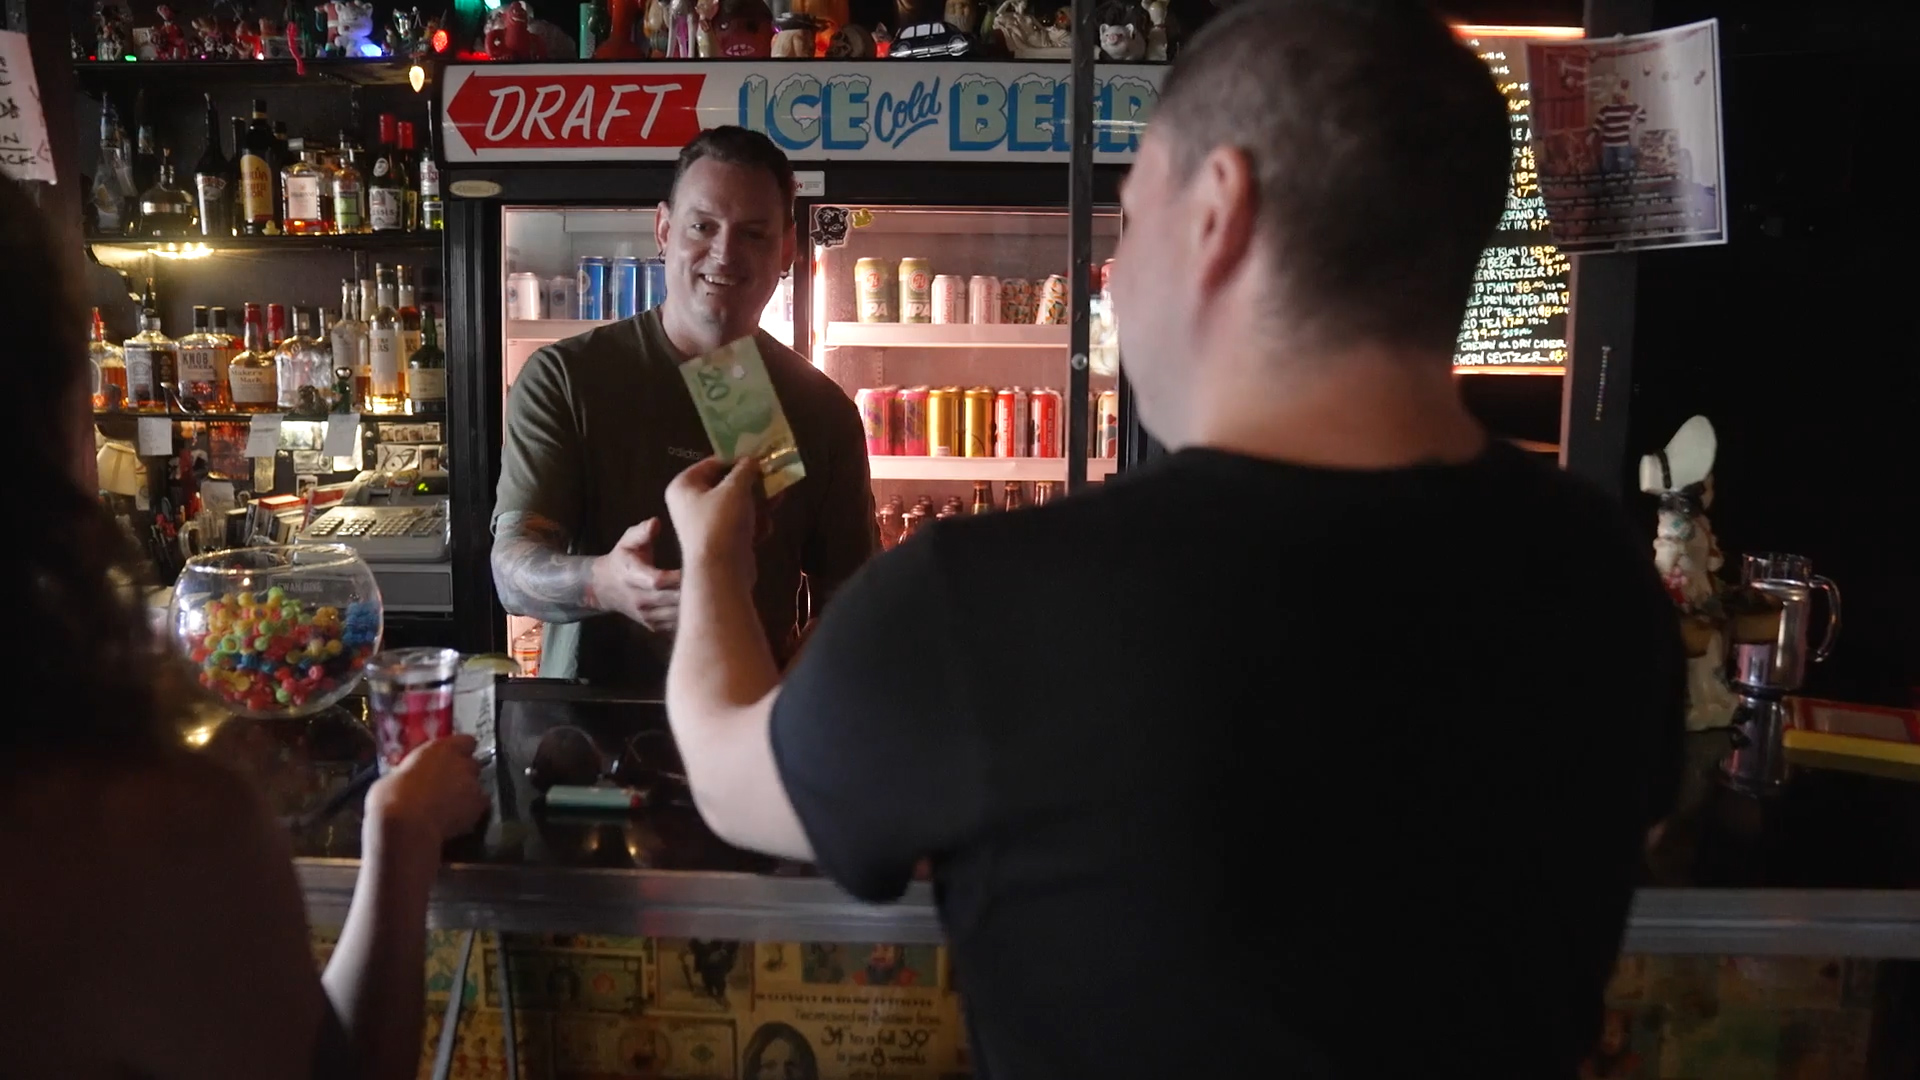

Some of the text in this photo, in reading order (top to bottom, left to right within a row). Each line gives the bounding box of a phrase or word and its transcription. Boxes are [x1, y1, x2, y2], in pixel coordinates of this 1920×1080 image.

[484, 83, 683, 142] DRAFT
[738, 73, 871, 150] ICE
[874, 76, 942, 143] Cold
[1513, 220, 1529, 231] IPA
[1486, 256, 1517, 270] BEER
[1520, 256, 1537, 267] ALE
[1483, 294, 1502, 306] DRY
[1480, 305, 1493, 317] UP
[1494, 306, 1514, 318] THE
[1513, 306, 1538, 318] JAM
[1479, 316, 1501, 329] TEA
[1512, 339, 1532, 351] DRY
[1533, 339, 1567, 350] CIDER
[182, 352, 210, 366] KNOB
[1486, 351, 1549, 364] SELTZER
[697, 366, 731, 401] 20
